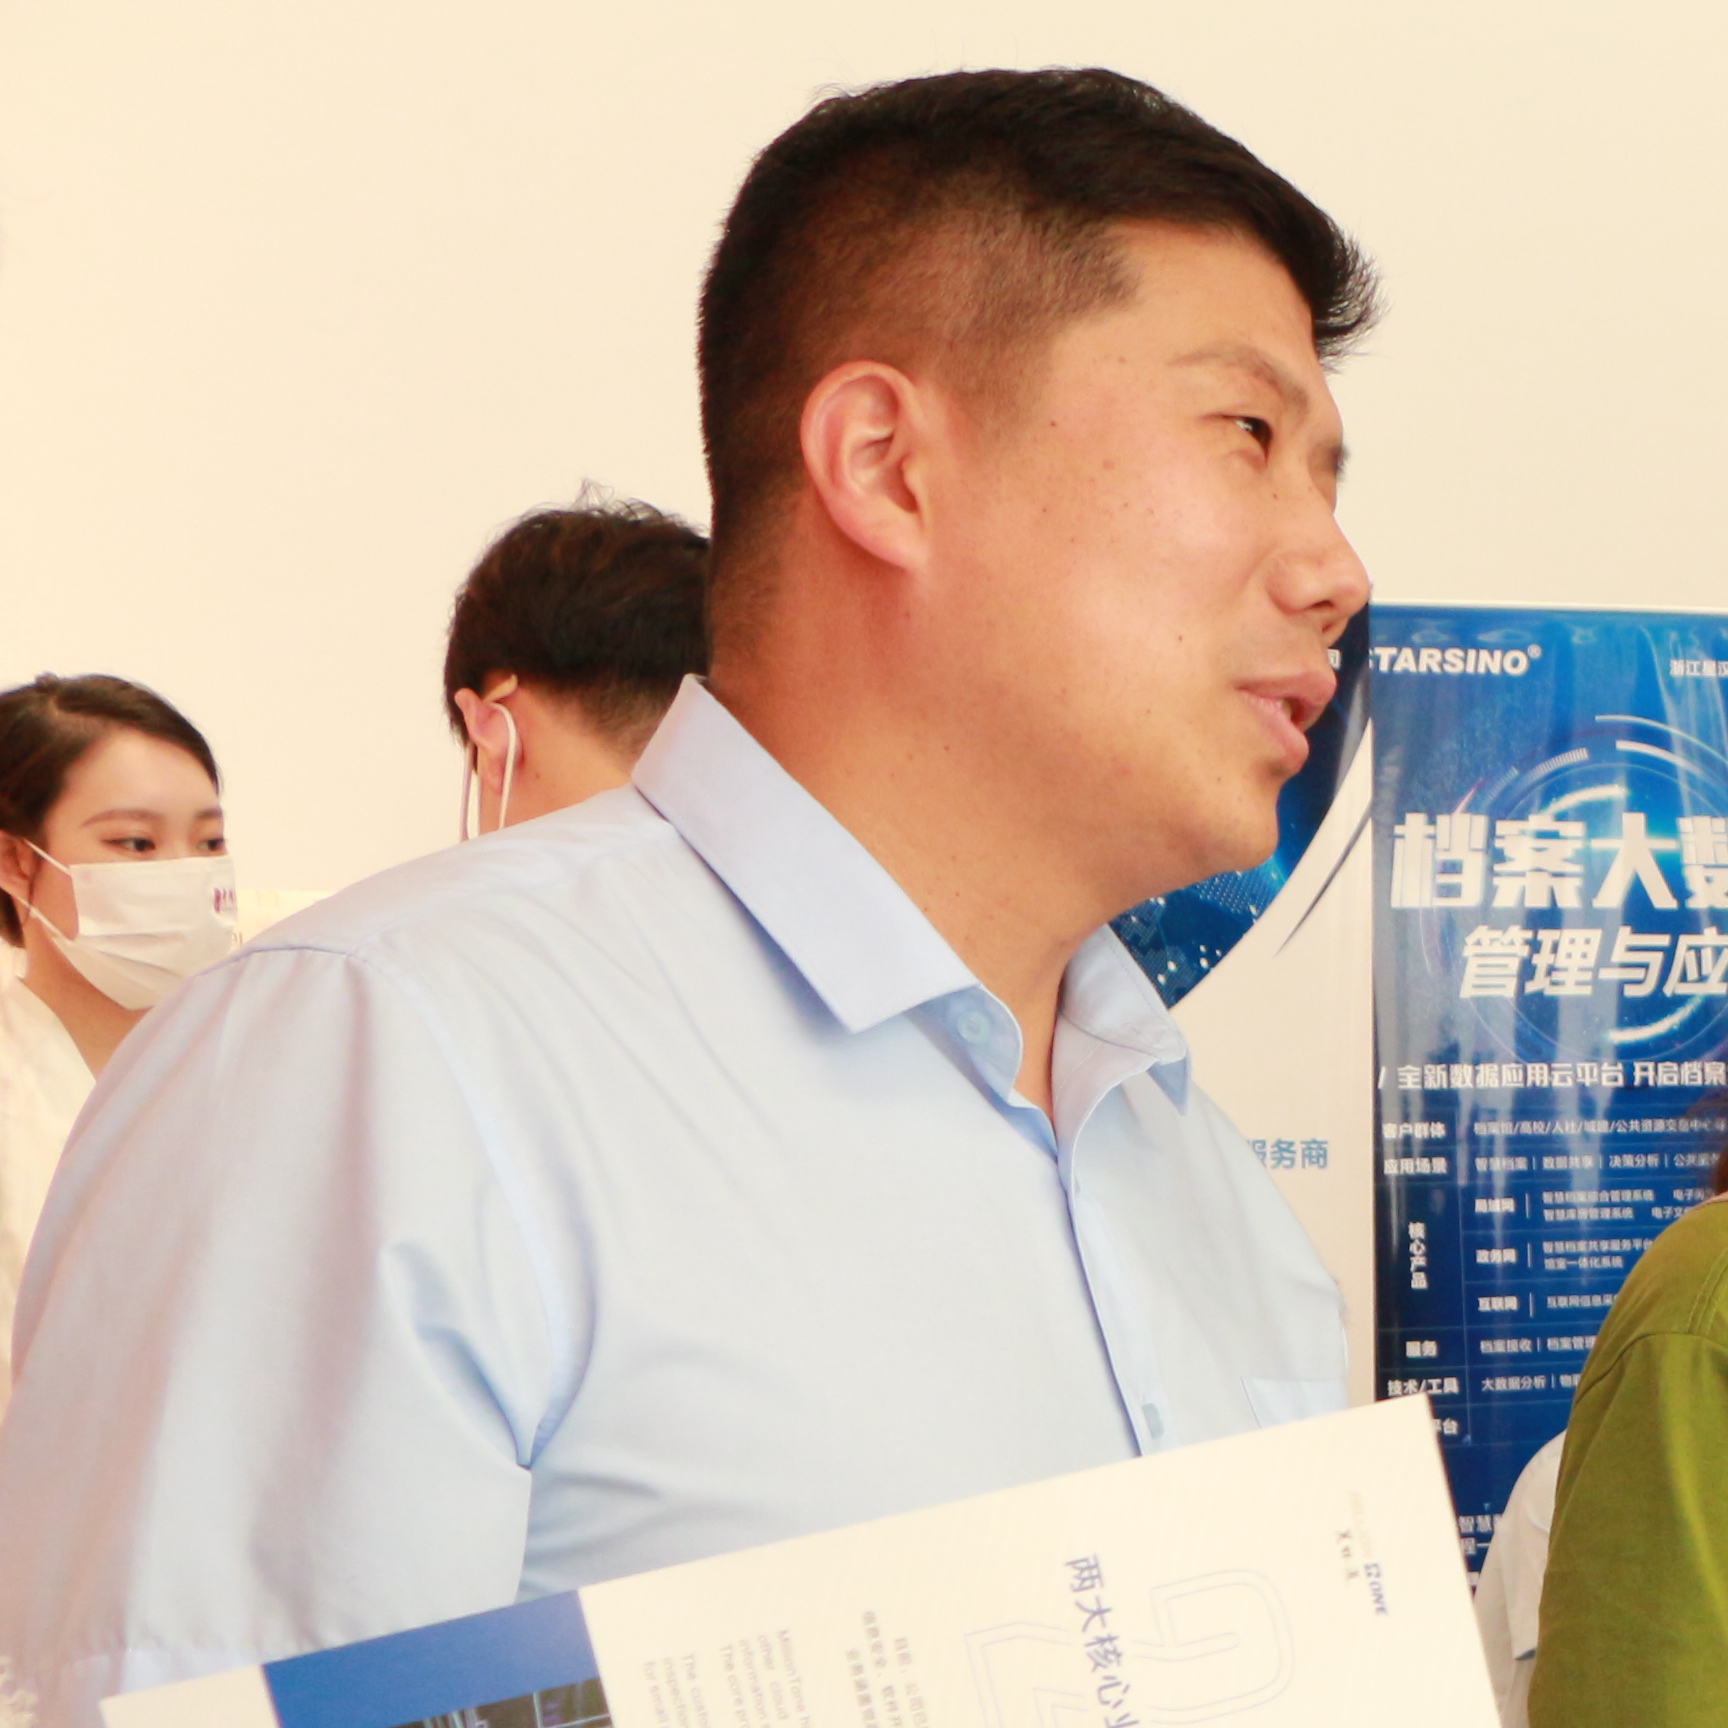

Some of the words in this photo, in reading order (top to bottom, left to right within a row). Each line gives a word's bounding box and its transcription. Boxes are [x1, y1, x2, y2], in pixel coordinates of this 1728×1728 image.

[1397, 1062, 1627, 1089] 全新数据应用云平台
[1382, 1121, 1447, 1139] 客户群体
[1383, 1156, 1448, 1175] 应用场景
[1407, 1221, 1429, 1290] 核心产品
[1405, 1338, 1439, 1359] 服务
[1386, 1375, 1460, 1397] 技术/工具
